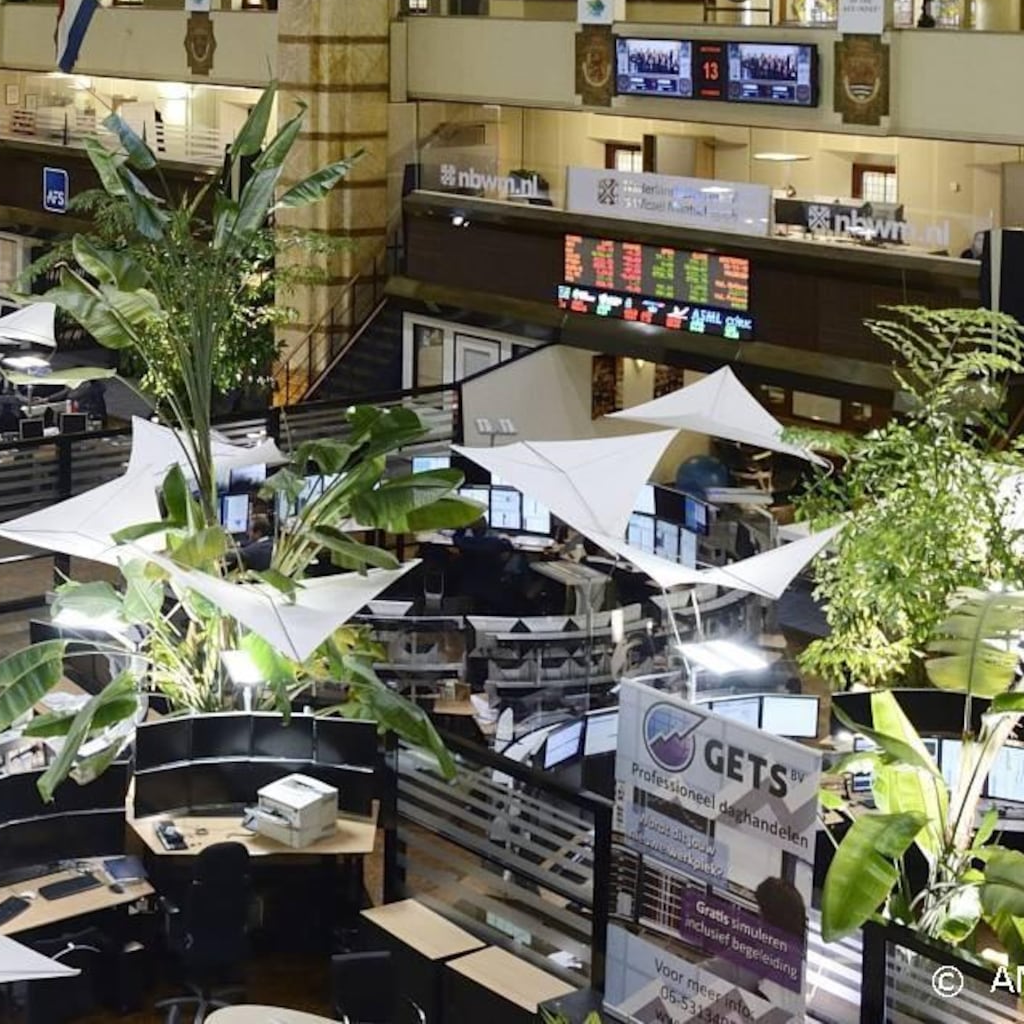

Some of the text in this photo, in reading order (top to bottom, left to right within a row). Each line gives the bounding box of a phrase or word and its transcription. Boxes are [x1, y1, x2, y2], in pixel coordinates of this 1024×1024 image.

[703, 61, 719, 81] 13
[704, 739, 788, 799] GETS
[632, 762, 716, 810] Professioneel
[719, 800, 809, 849] daghandelen
[685, 917, 798, 980] inclusief begeleiding
[696, 900, 788, 953] Gratis simuleren
[655, 957, 684, 984] Voor
[687, 977, 721, 1002] meer
